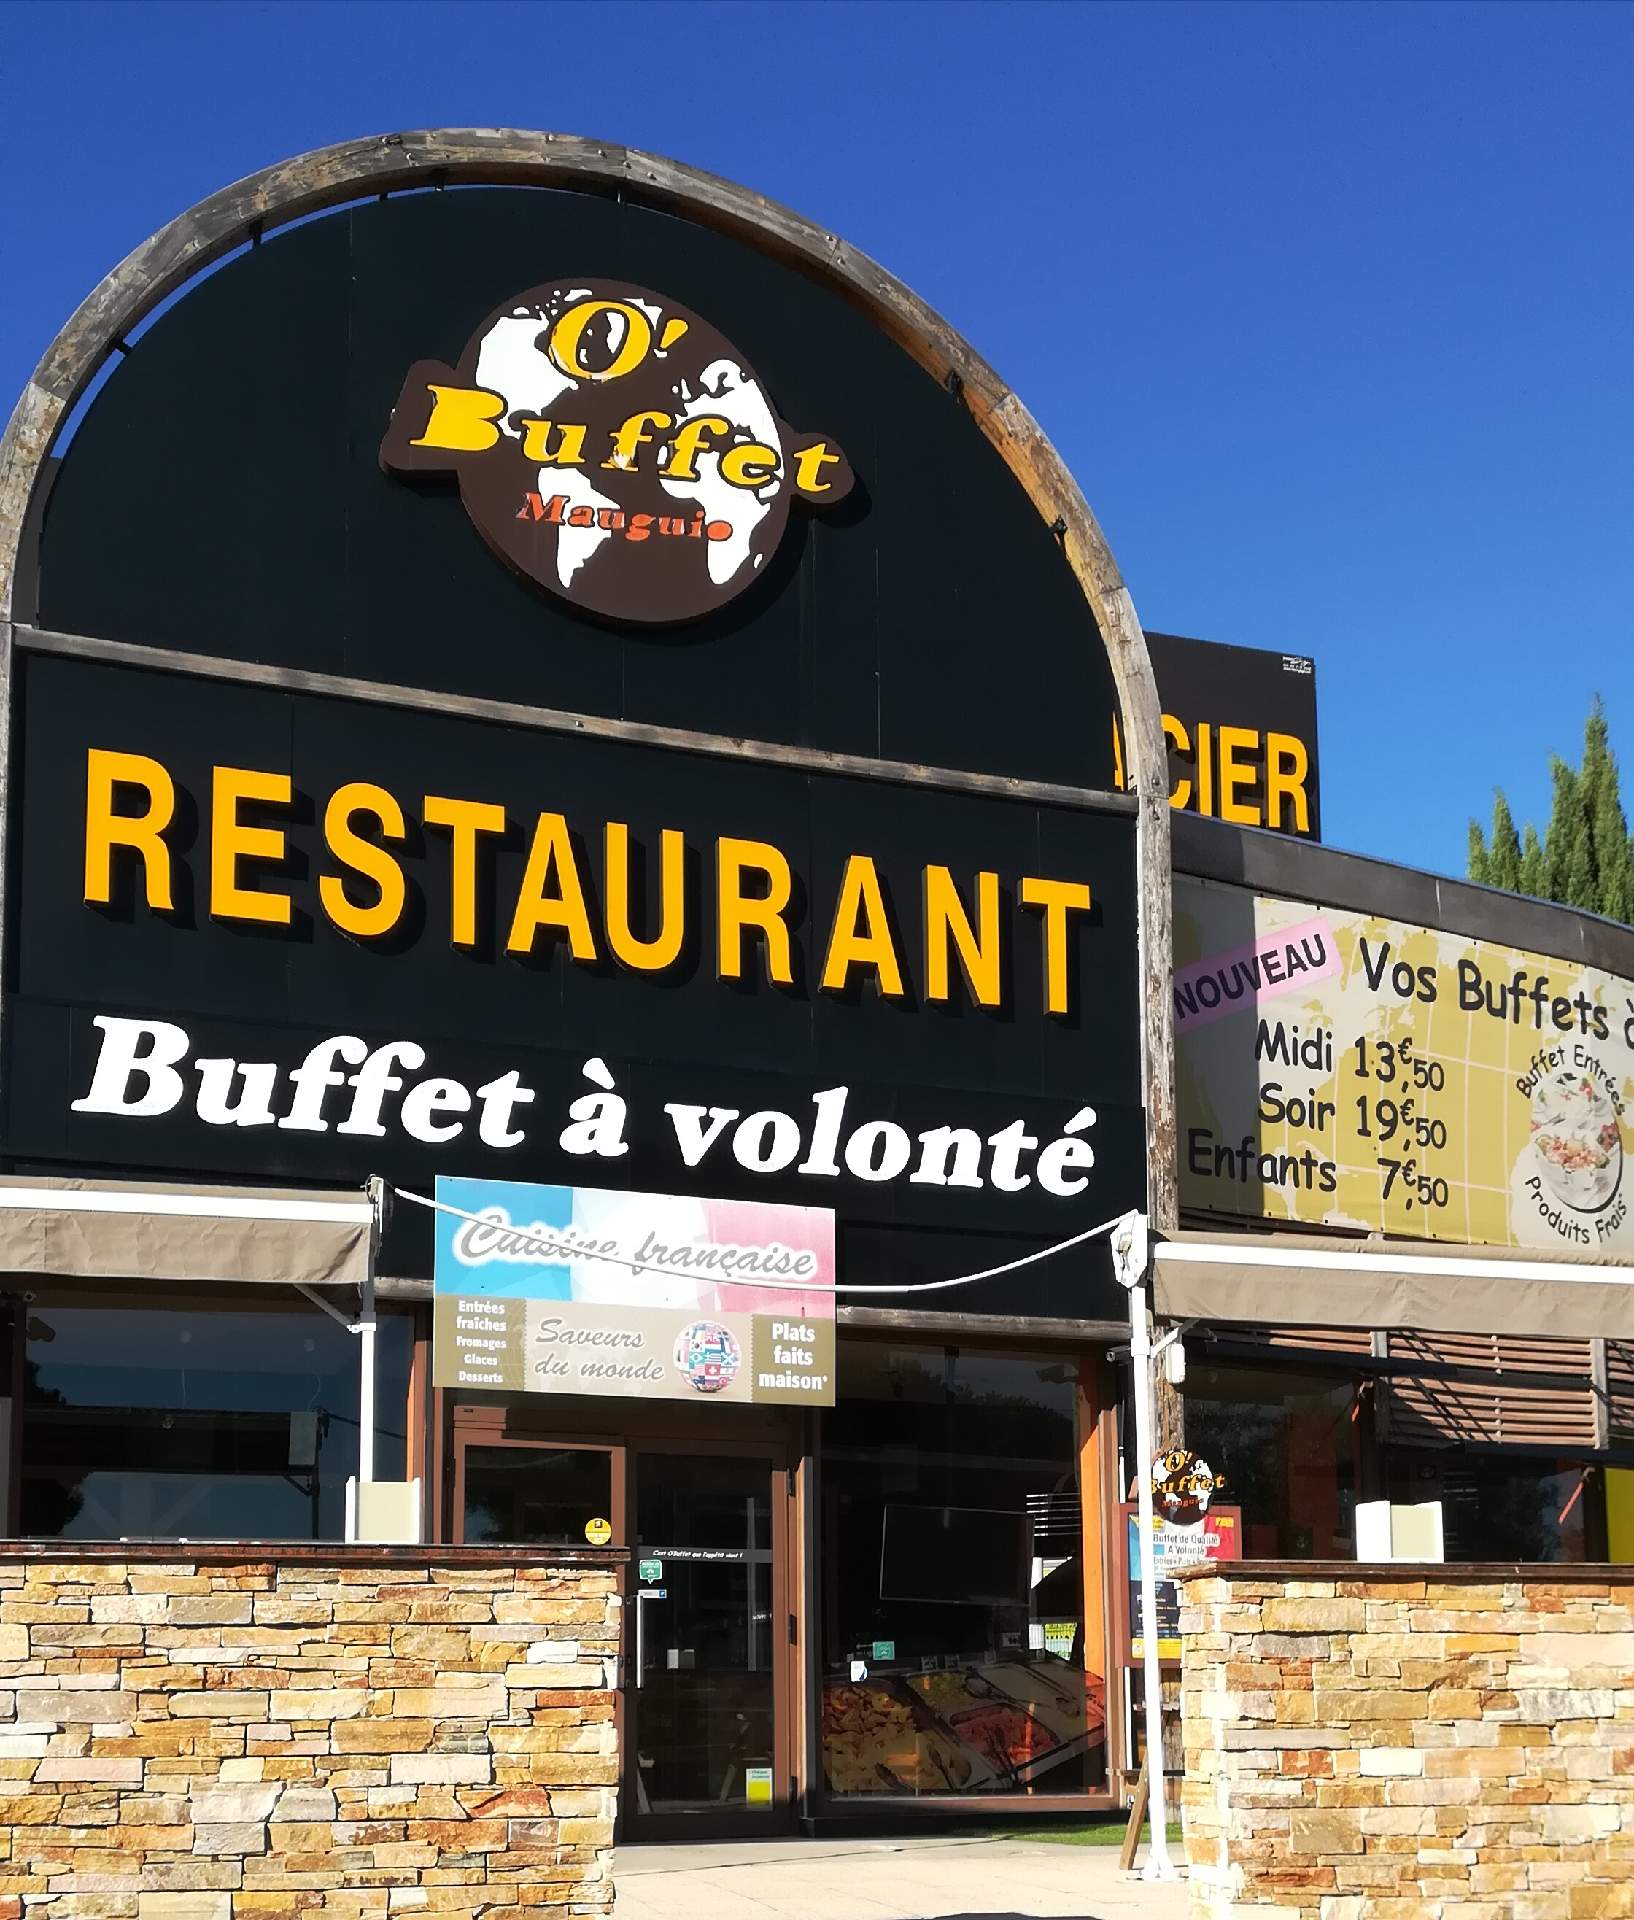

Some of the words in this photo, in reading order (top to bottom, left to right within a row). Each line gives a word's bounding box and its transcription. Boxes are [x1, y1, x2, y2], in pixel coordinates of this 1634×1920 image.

[410, 384, 840, 492] Buffet
[516, 492, 733, 542] Mauguio
[84, 747, 1092, 1015] RESTAURANT
[1174, 933, 1327, 1019] NOUVEAU
[1359, 937, 1437, 1004] Vos
[1458, 959, 1610, 1041] Buffets
[1254, 1018, 1333, 1072] Midi
[1516, 1045, 1565, 1099] Buffet
[71, 1015, 535, 1148] Buffet
[559, 1057, 629, 1158] à
[664, 1086, 1097, 1197] volonté
[1257, 1082, 1336, 1131] Soir
[1188, 1128, 1337, 1192] Enfants
[1525, 1176, 1590, 1244] Produits
[1595, 1193, 1628, 1243] Frais
[631, 1230, 813, 1277] française
[456, 1315, 507, 1332] fraîches
[458, 1299, 506, 1314] Entrées
[456, 1335, 507, 1351] Fromages
[535, 1318, 645, 1348] Saveurs
[772, 1322, 816, 1343] Plats
[773, 1345, 814, 1366] faits
[458, 1370, 504, 1383] Desserts
[464, 1353, 498, 1366] Glaces
[534, 1353, 569, 1376] du
[580, 1358, 665, 1380] monde
